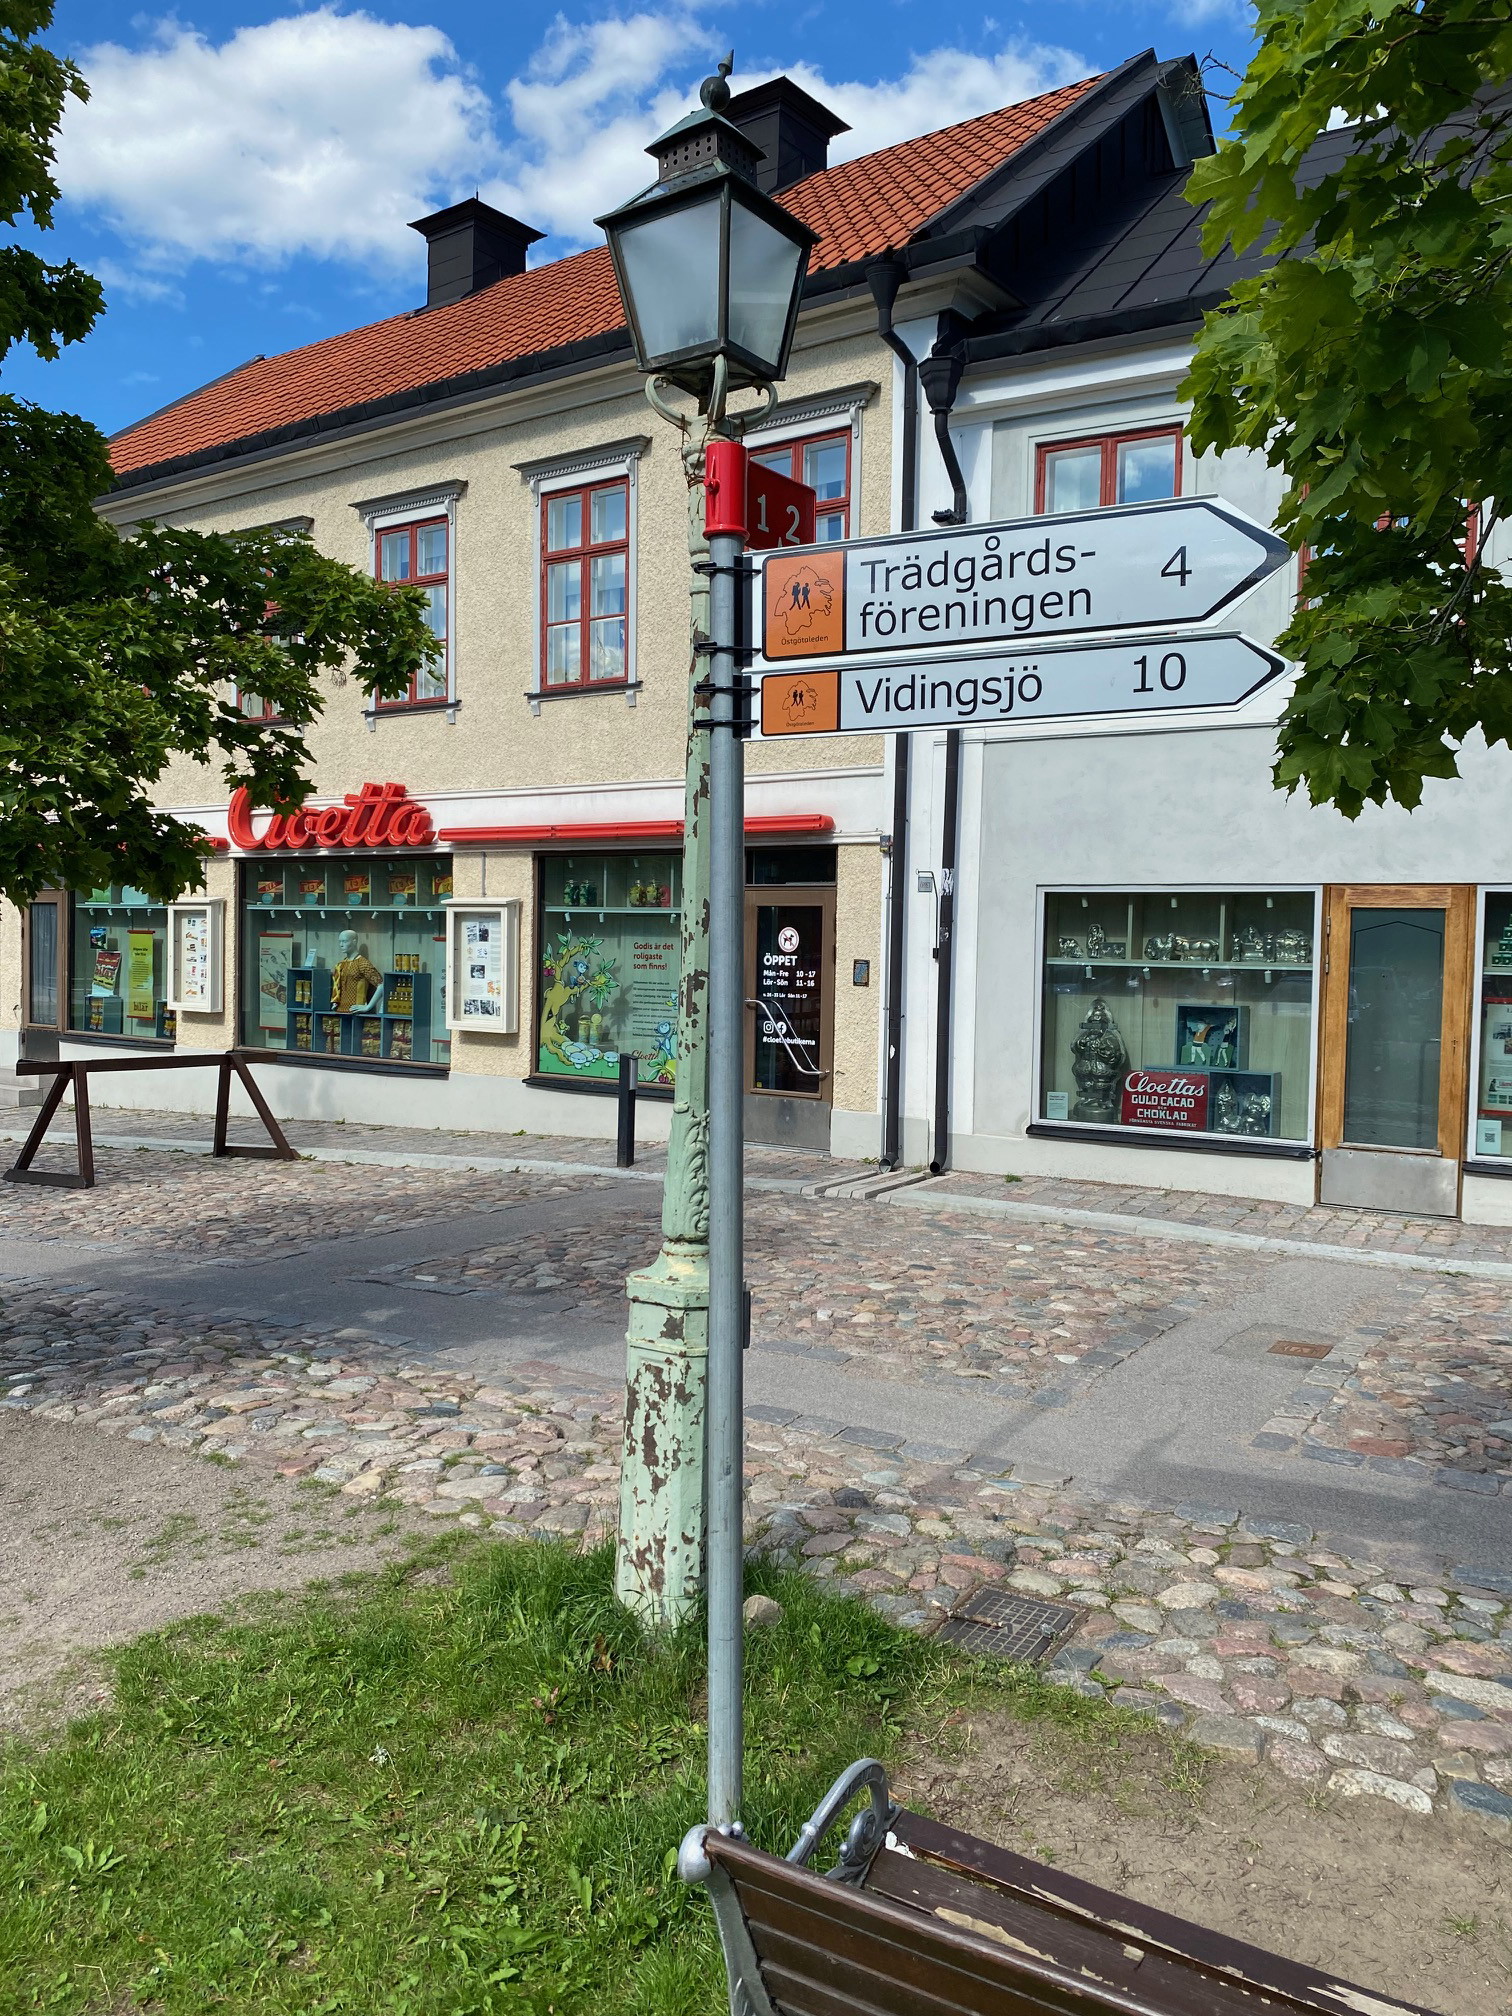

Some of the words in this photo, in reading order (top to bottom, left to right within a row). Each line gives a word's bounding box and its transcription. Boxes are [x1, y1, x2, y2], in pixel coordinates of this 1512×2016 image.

[860, 535, 1097, 594] Trädgårds-
[1160, 545, 1193, 587] 4
[859, 587, 1092, 638] föreningen
[781, 635, 829, 646] Östgötaleden
[855, 665, 1043, 716] Vidingsjö
[1132, 652, 1188, 693] 10
[633, 942, 653, 951] Godis
[654, 942, 662, 950] är
[633, 953, 663, 961] roligaste
[763, 952, 798, 967] ÖPPET
[648, 962, 668, 971] finns!
[631, 1049, 658, 1060] Cloett
[1125, 1071, 1205, 1096] Cloettas
[1131, 1095, 1158, 1105] GULD
[1160, 1096, 1195, 1108] CACAO
[1137, 1108, 1188, 1121] CHOKLAD
